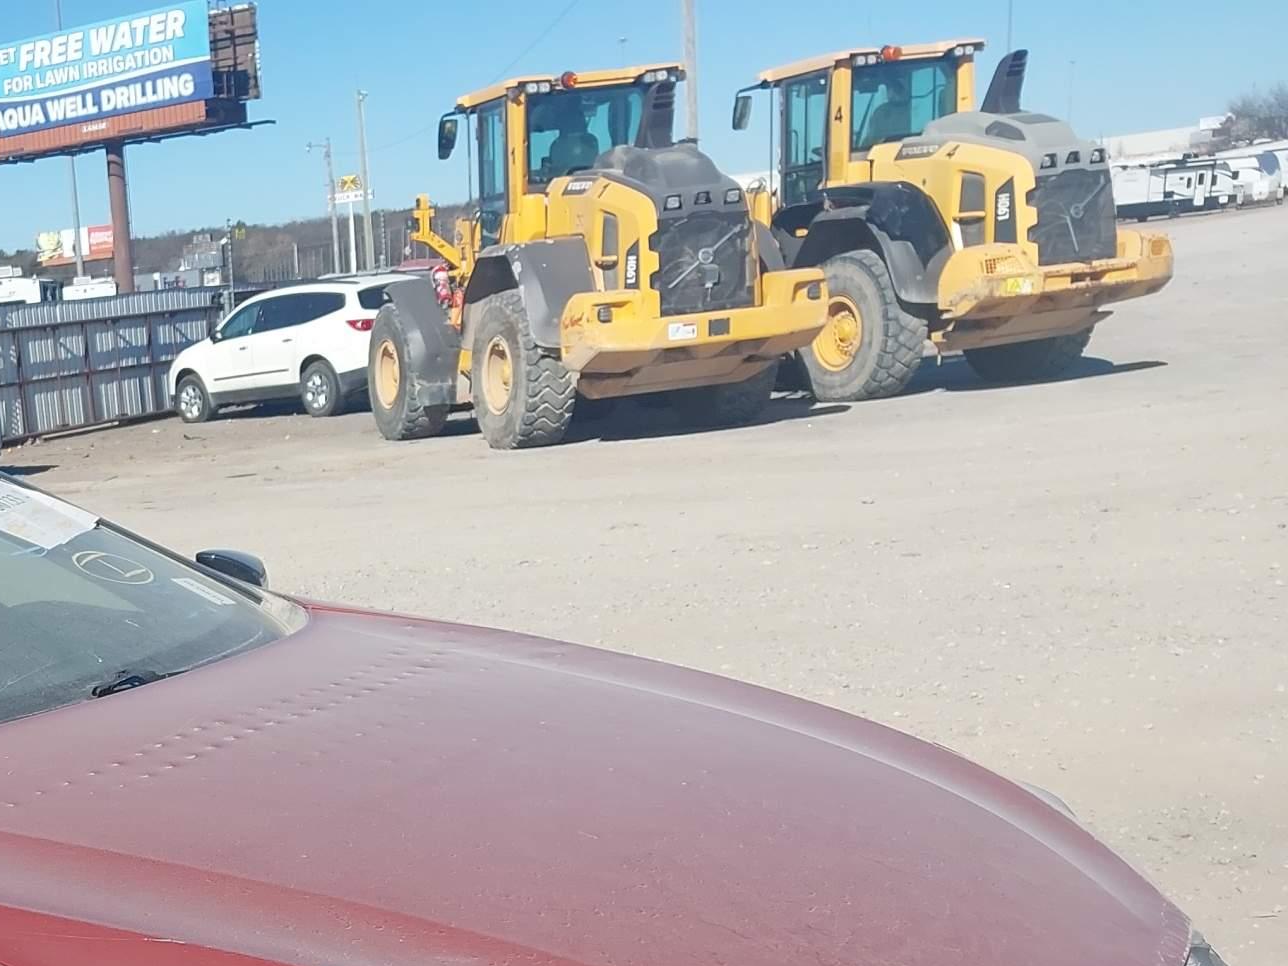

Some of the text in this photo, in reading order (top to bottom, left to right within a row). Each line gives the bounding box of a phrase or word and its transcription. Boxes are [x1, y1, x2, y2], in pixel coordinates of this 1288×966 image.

[19, 32, 84, 72] FREE
[88, 9, 186, 57] WATER
[2, 44, 175, 96] FOR LAWN IRRIGATION
[45, 92, 99, 122] WELL
[99, 72, 195, 112] DRILLING
[834, 105, 843, 123] 4
[625, 255, 638, 284] L90H
